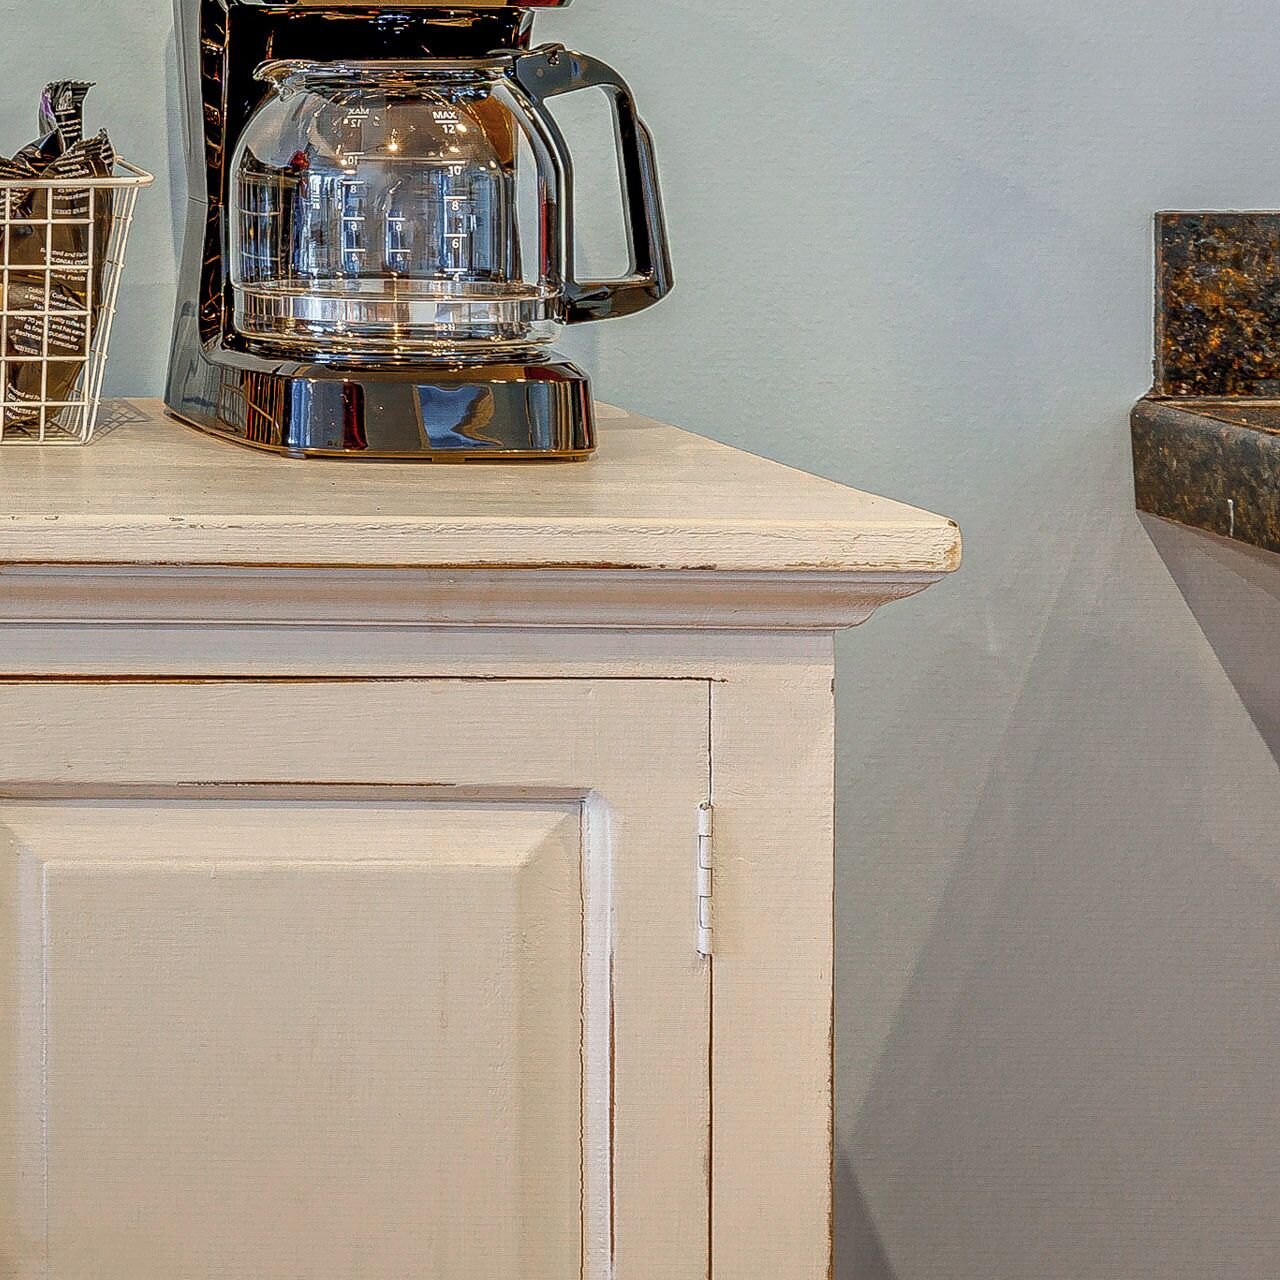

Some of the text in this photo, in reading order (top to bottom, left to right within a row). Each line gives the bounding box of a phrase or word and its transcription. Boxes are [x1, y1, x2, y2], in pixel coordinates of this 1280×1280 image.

[432, 110, 457, 120] MAX
[442, 124, 456, 134] 12
[448, 165, 462, 176] 10
[451, 202, 459, 211] 8
[452, 238, 460, 248] 6
[452, 273, 460, 283] 4
[52, 292, 68, 301] Coffee
[14, 328, 42, 341] freshness
